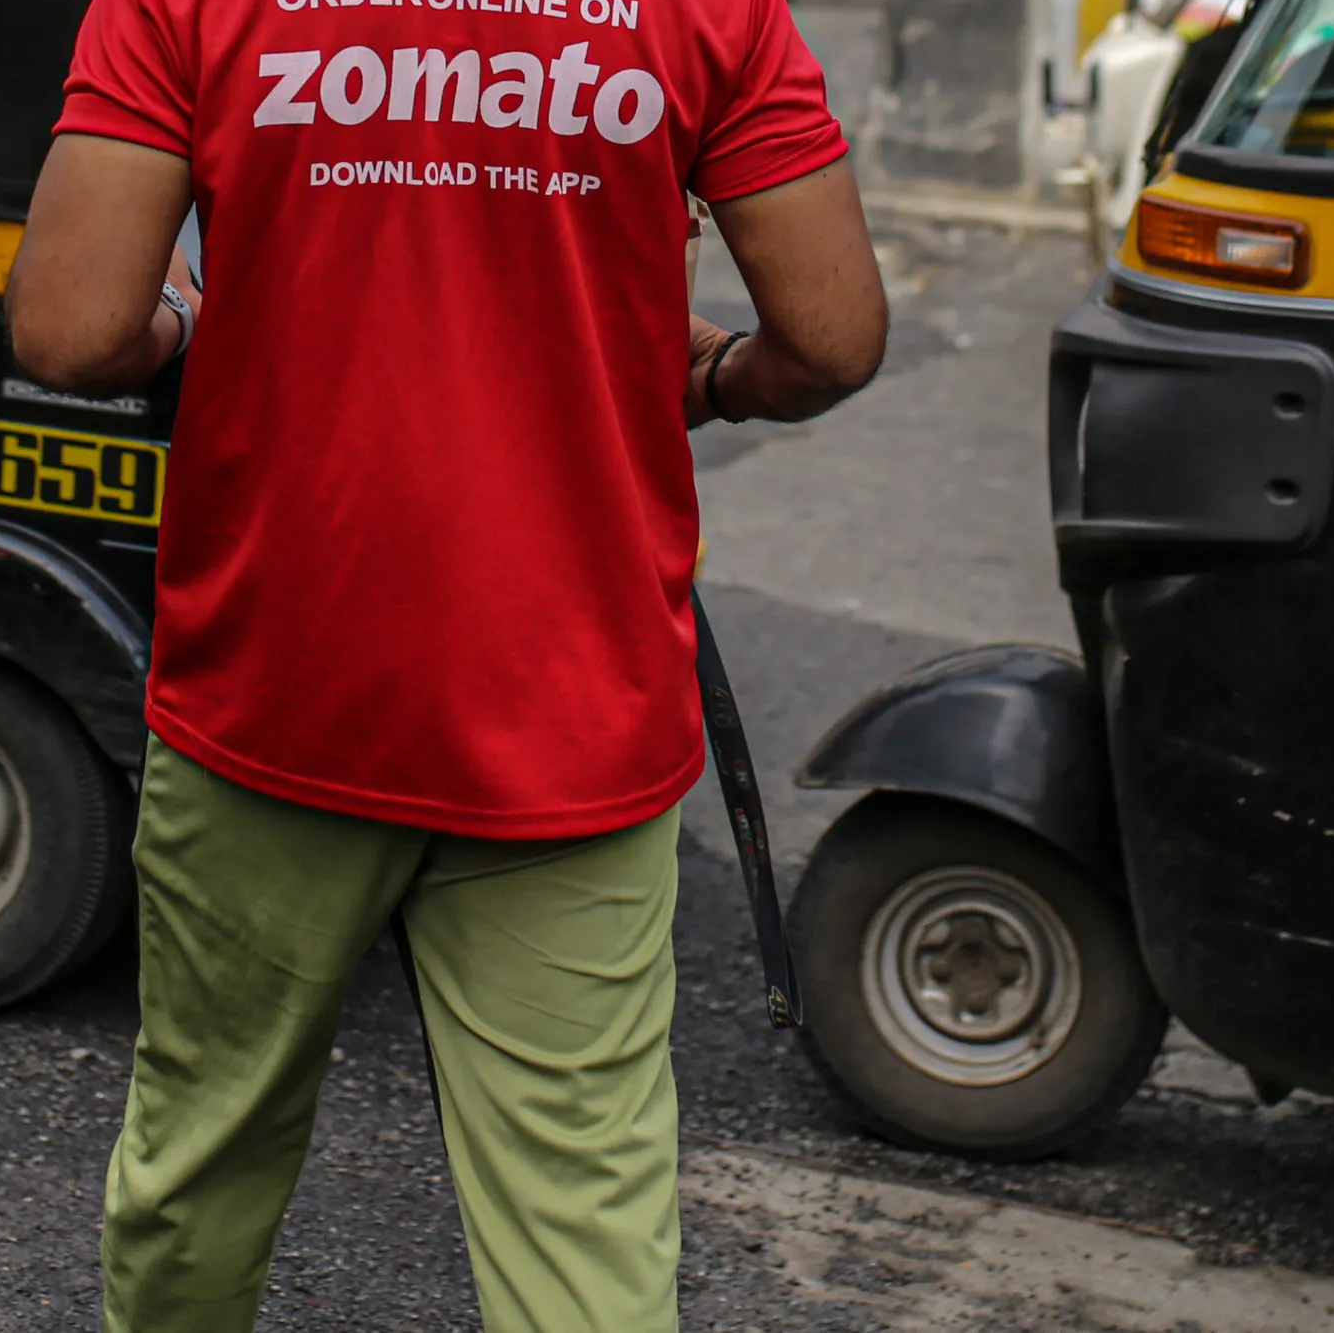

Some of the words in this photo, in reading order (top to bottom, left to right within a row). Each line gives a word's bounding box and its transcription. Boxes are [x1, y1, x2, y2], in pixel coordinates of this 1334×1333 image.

[253, 40, 665, 145] zomato
[309, 160, 477, 187] DOWNLOAD
[484, 165, 540, 194] THE
[544, 172, 602, 197] APP
